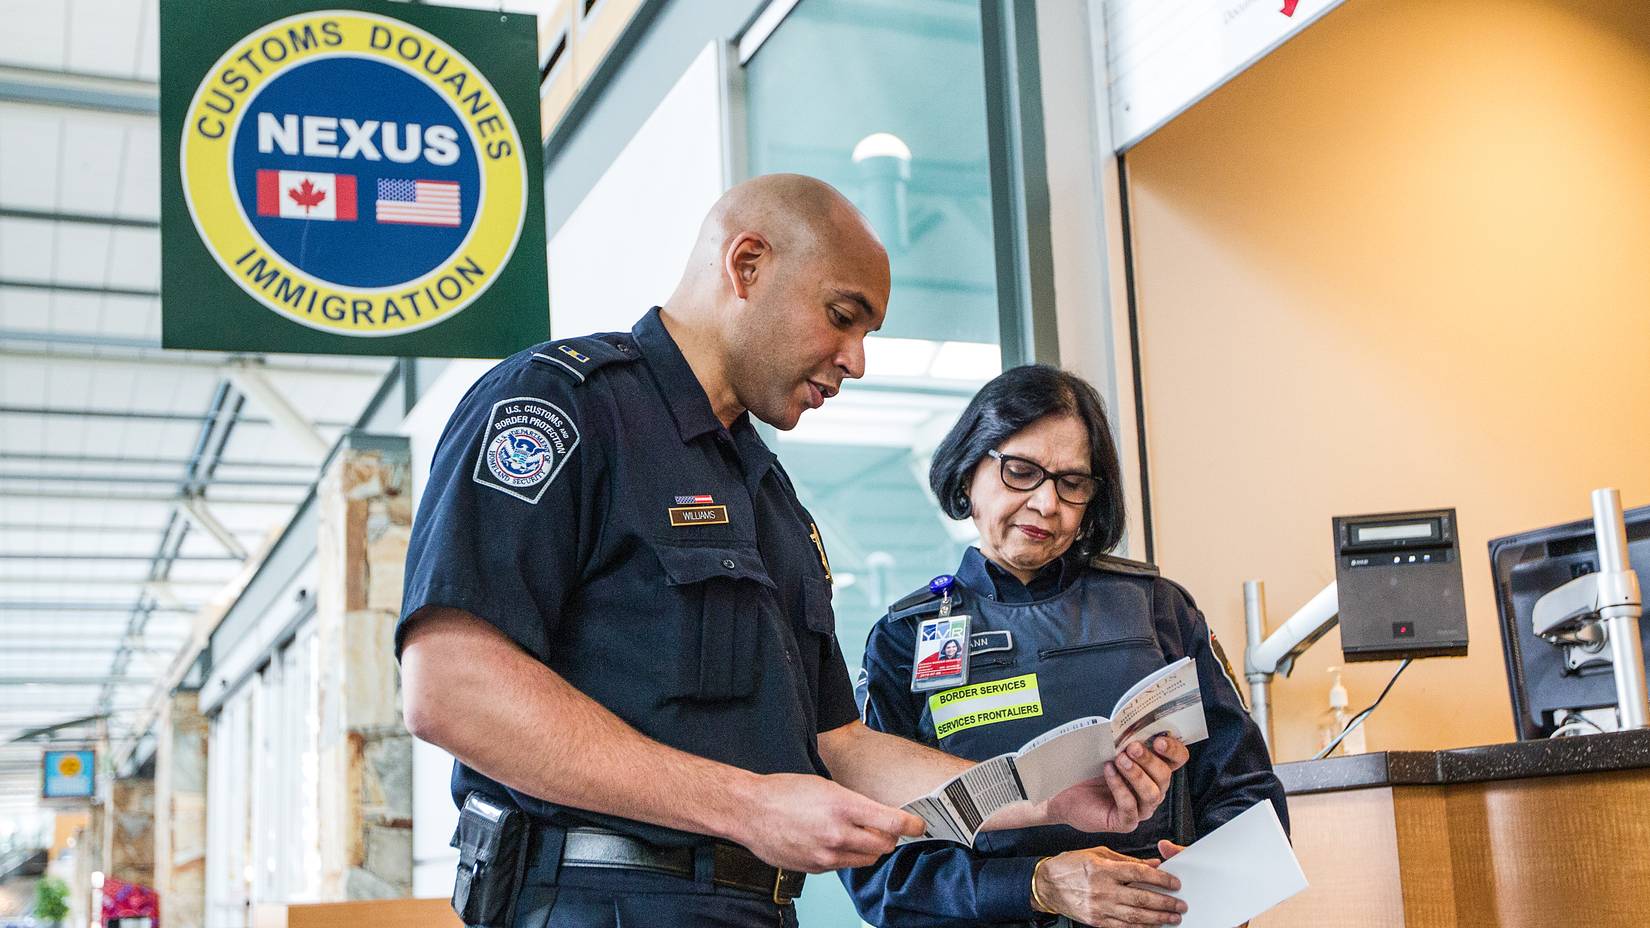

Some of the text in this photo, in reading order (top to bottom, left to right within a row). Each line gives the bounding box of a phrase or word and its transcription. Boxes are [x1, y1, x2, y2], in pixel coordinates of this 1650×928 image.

[197, 21, 512, 161] CUSTOMS DOUANES
[257, 111, 462, 166] NEXUS
[236, 247, 485, 325] IMMIGRATION
[505, 405, 521, 415] U.S.
[524, 404, 563, 428] CUSTOMS
[494, 415, 566, 455] BORDER PROTECTION
[488, 450, 546, 485] HOMELAND SECURITY
[682, 510, 716, 521] WILLIAMS
[940, 680, 1026, 704] BORDER SERVICES
[937, 704, 1039, 735] SERVICES FRONTALIERS
